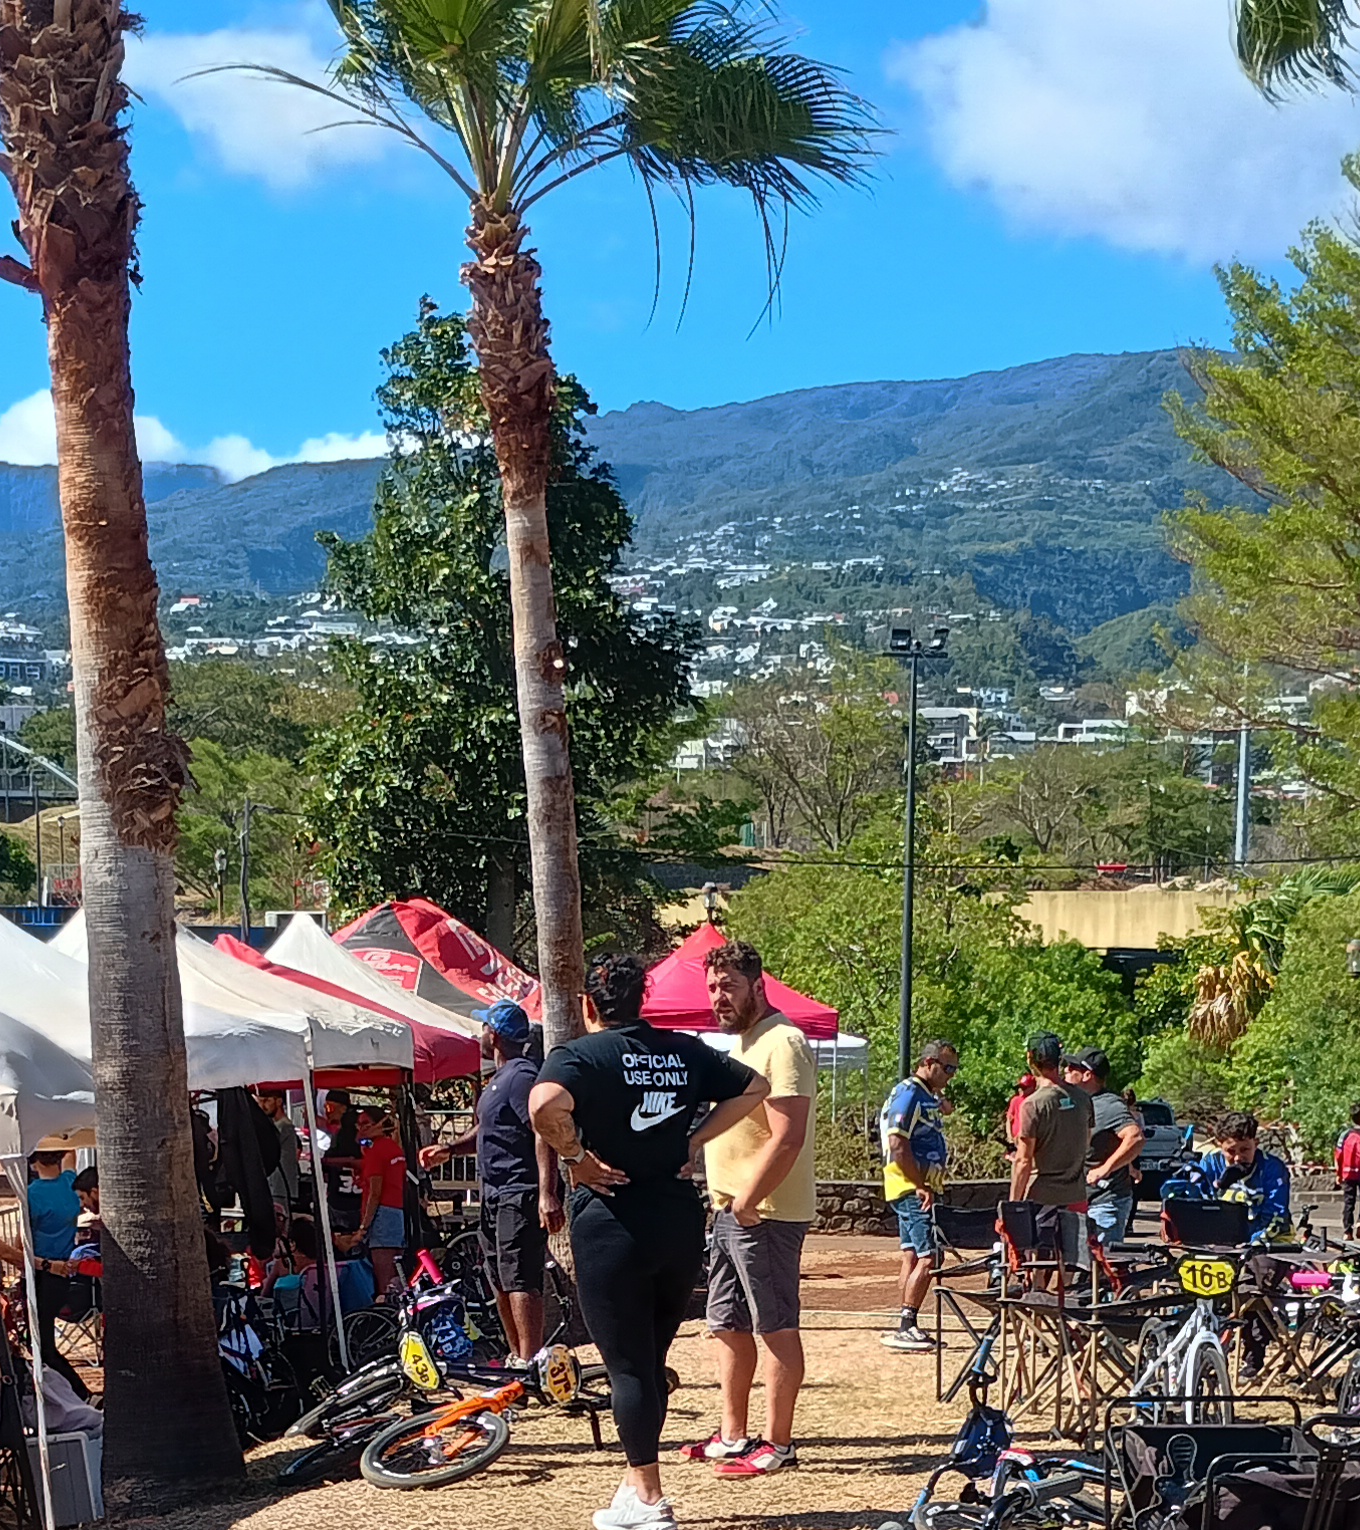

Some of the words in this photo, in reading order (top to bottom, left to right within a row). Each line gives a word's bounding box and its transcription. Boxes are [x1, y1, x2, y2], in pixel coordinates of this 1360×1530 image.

[623, 1070, 652, 1085] USE
[653, 1070, 688, 1087] ONLY
[640, 1091, 677, 1115] NIKE
[1185, 1263, 1227, 1289] 16B
[411, 1352, 430, 1384] 43B
